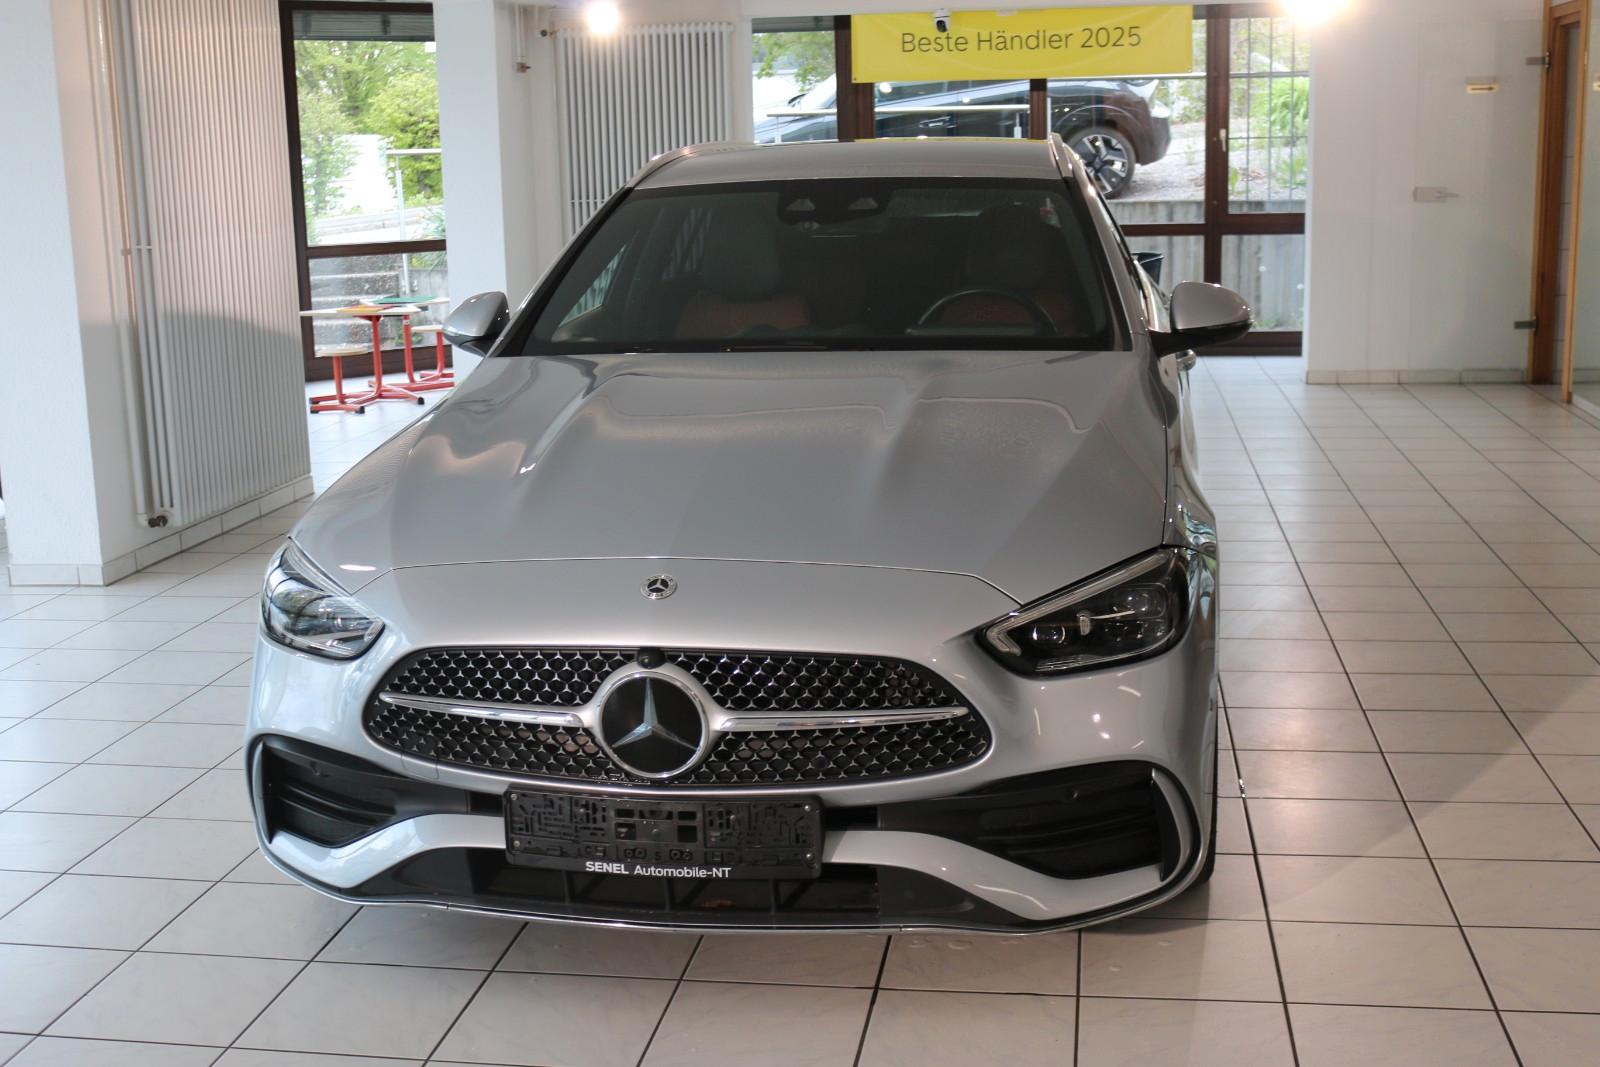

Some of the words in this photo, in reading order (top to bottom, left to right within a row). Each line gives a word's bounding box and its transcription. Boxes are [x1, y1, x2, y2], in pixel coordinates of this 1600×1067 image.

[901, 31, 969, 53] Beste
[976, 29, 1073, 52] Händler
[1080, 26, 1142, 49] 2025
[585, 861, 629, 875] SENEL
[633, 864, 732, 878] Automobile-NT
